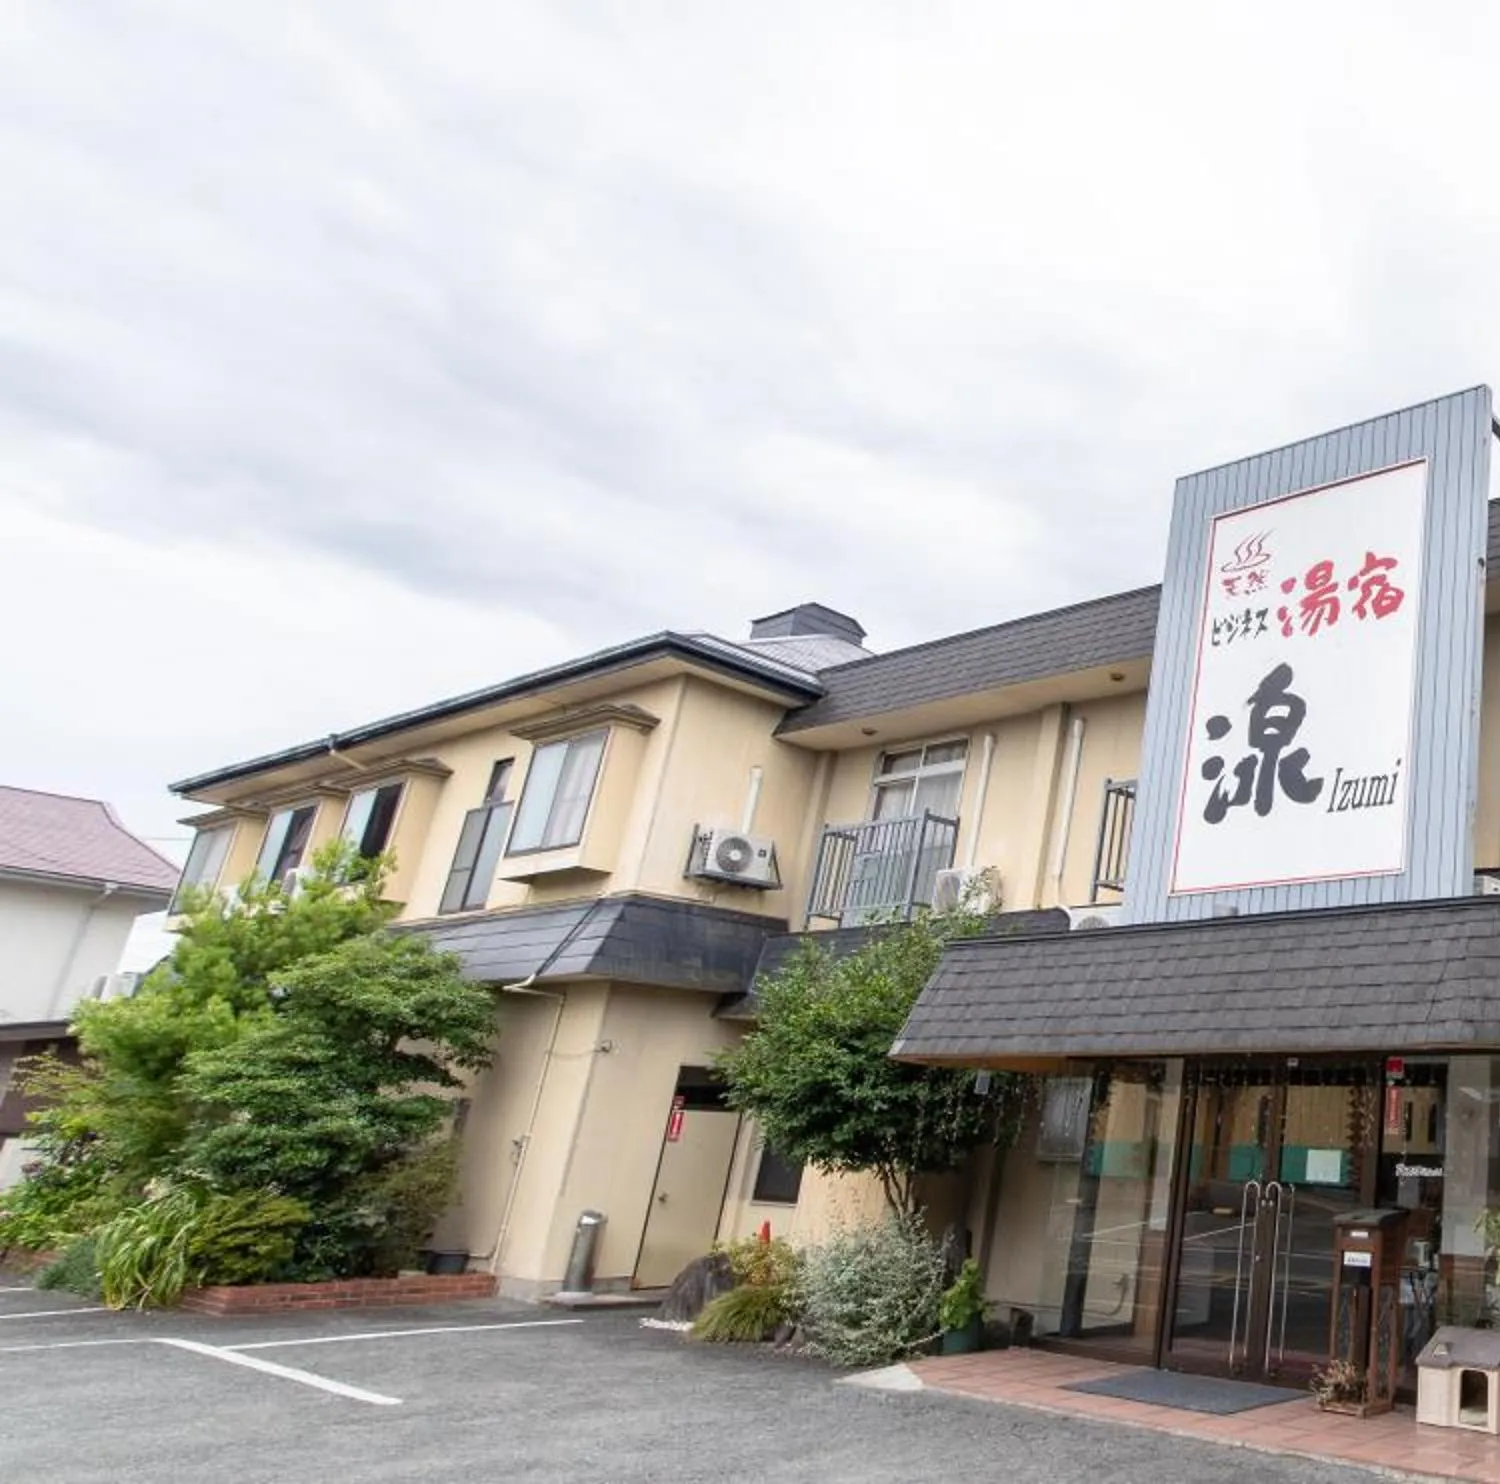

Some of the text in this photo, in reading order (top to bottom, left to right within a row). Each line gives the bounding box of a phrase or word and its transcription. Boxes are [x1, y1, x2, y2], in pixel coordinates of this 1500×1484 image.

[1212, 552, 1405, 646] ビジネス 湯宿
[1222, 570, 1270, 596] 天然
[1327, 758, 1402, 813] Izumi
